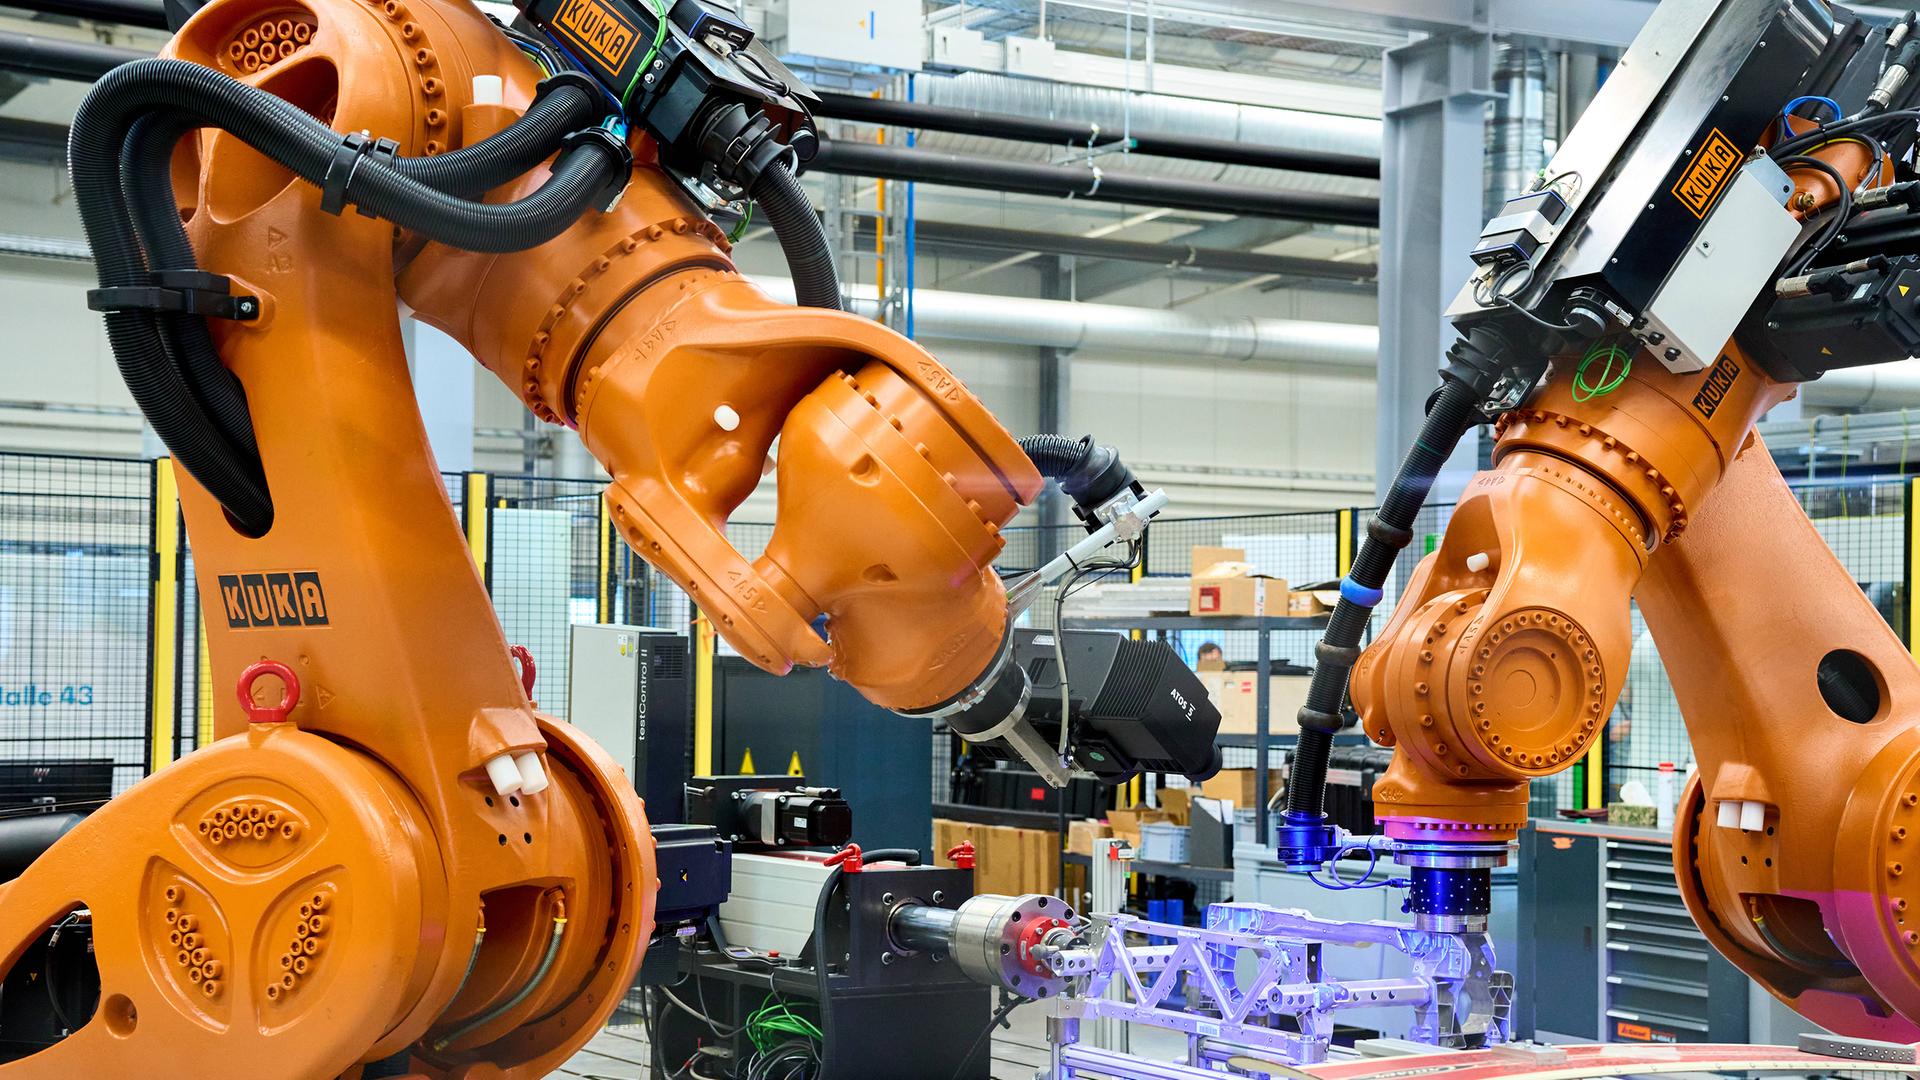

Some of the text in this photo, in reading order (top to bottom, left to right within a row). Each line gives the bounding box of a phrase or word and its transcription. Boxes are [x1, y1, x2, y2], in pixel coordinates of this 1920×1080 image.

[566, 0, 627, 58] KUKA
[1685, 145, 1731, 205] KUKA
[1696, 358, 1739, 415] KUKA
[222, 580, 326, 621] KUKA
[0, 684, 94, 706] alle 43
[638, 662, 649, 742] testControl
[1170, 688, 1188, 710] ATOS
